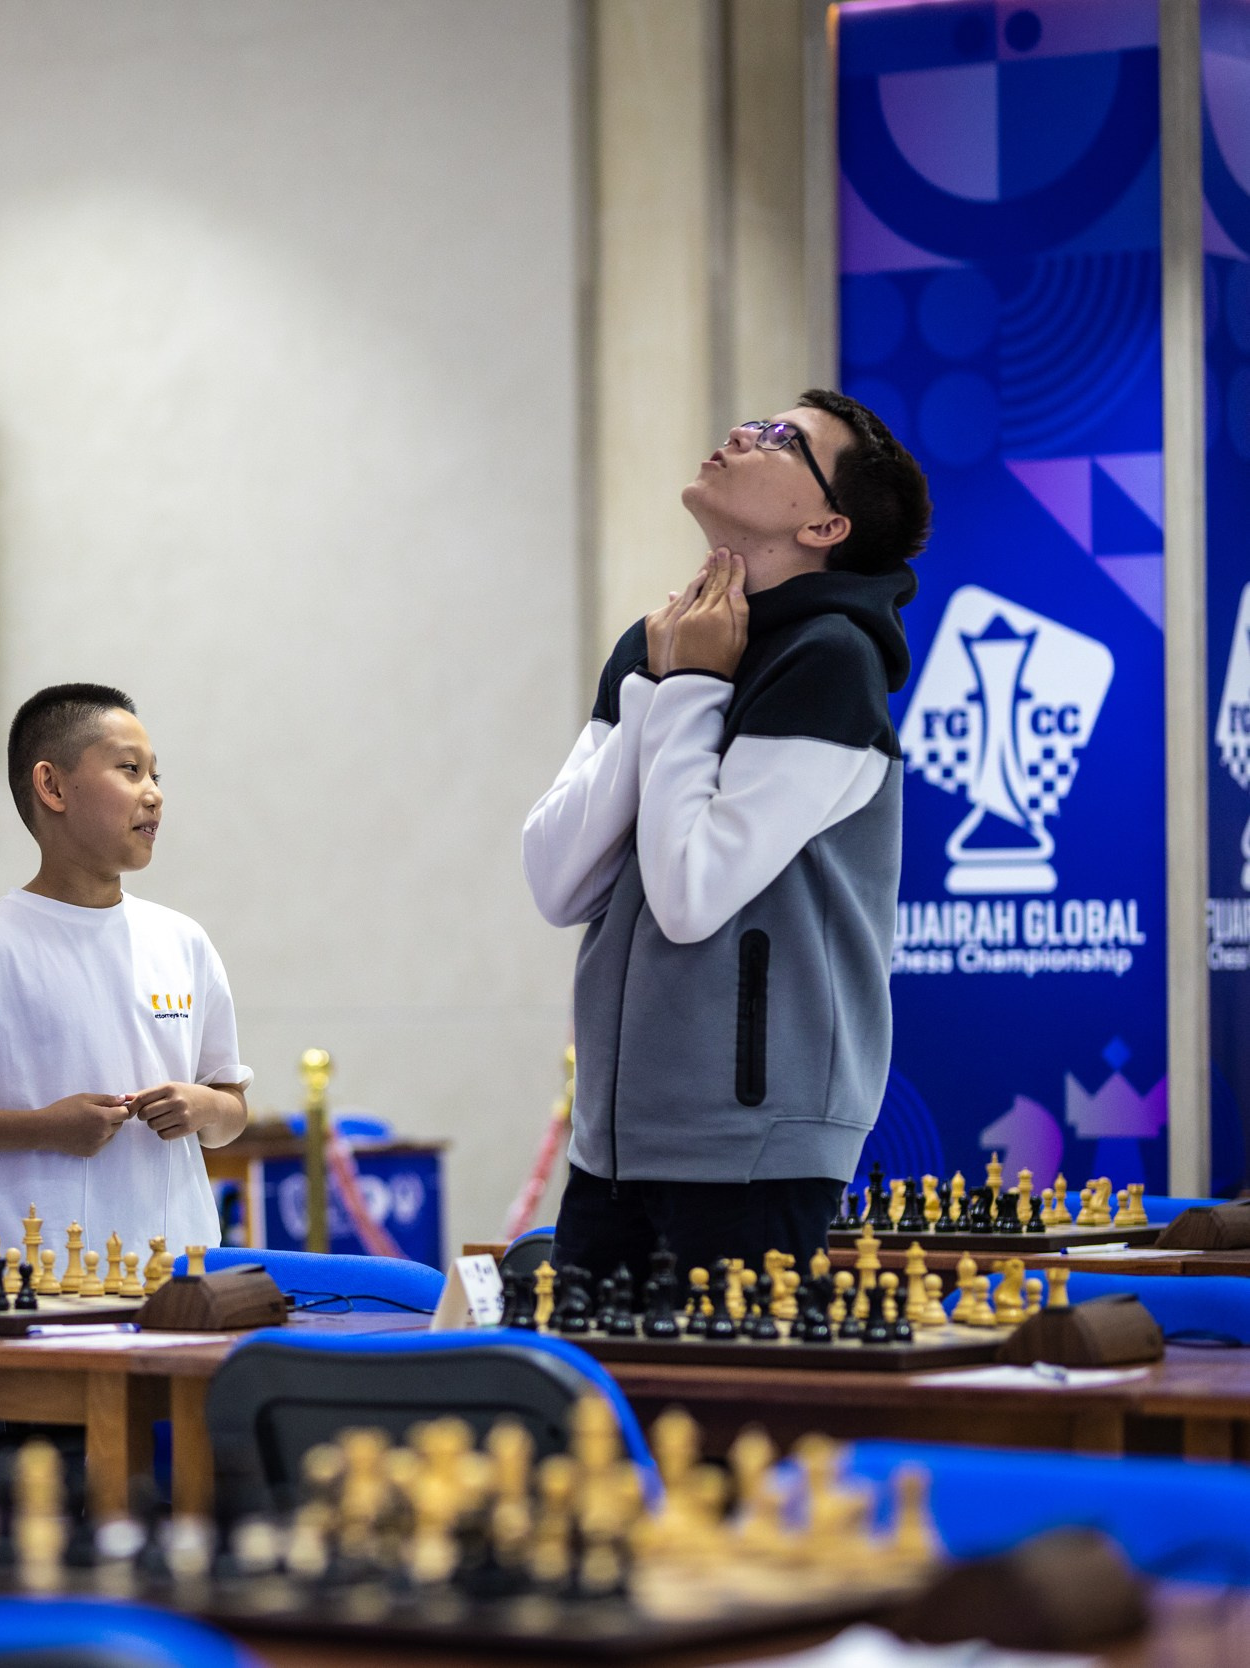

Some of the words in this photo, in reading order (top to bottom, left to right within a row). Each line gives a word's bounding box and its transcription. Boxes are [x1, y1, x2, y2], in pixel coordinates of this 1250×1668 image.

[922, 707, 969, 740] FG
[1030, 704, 1081, 737] CC
[893, 900, 1017, 948] UJAIRAH
[1022, 899, 1147, 947] GLOBAL
[956, 943, 1133, 978] Championship
